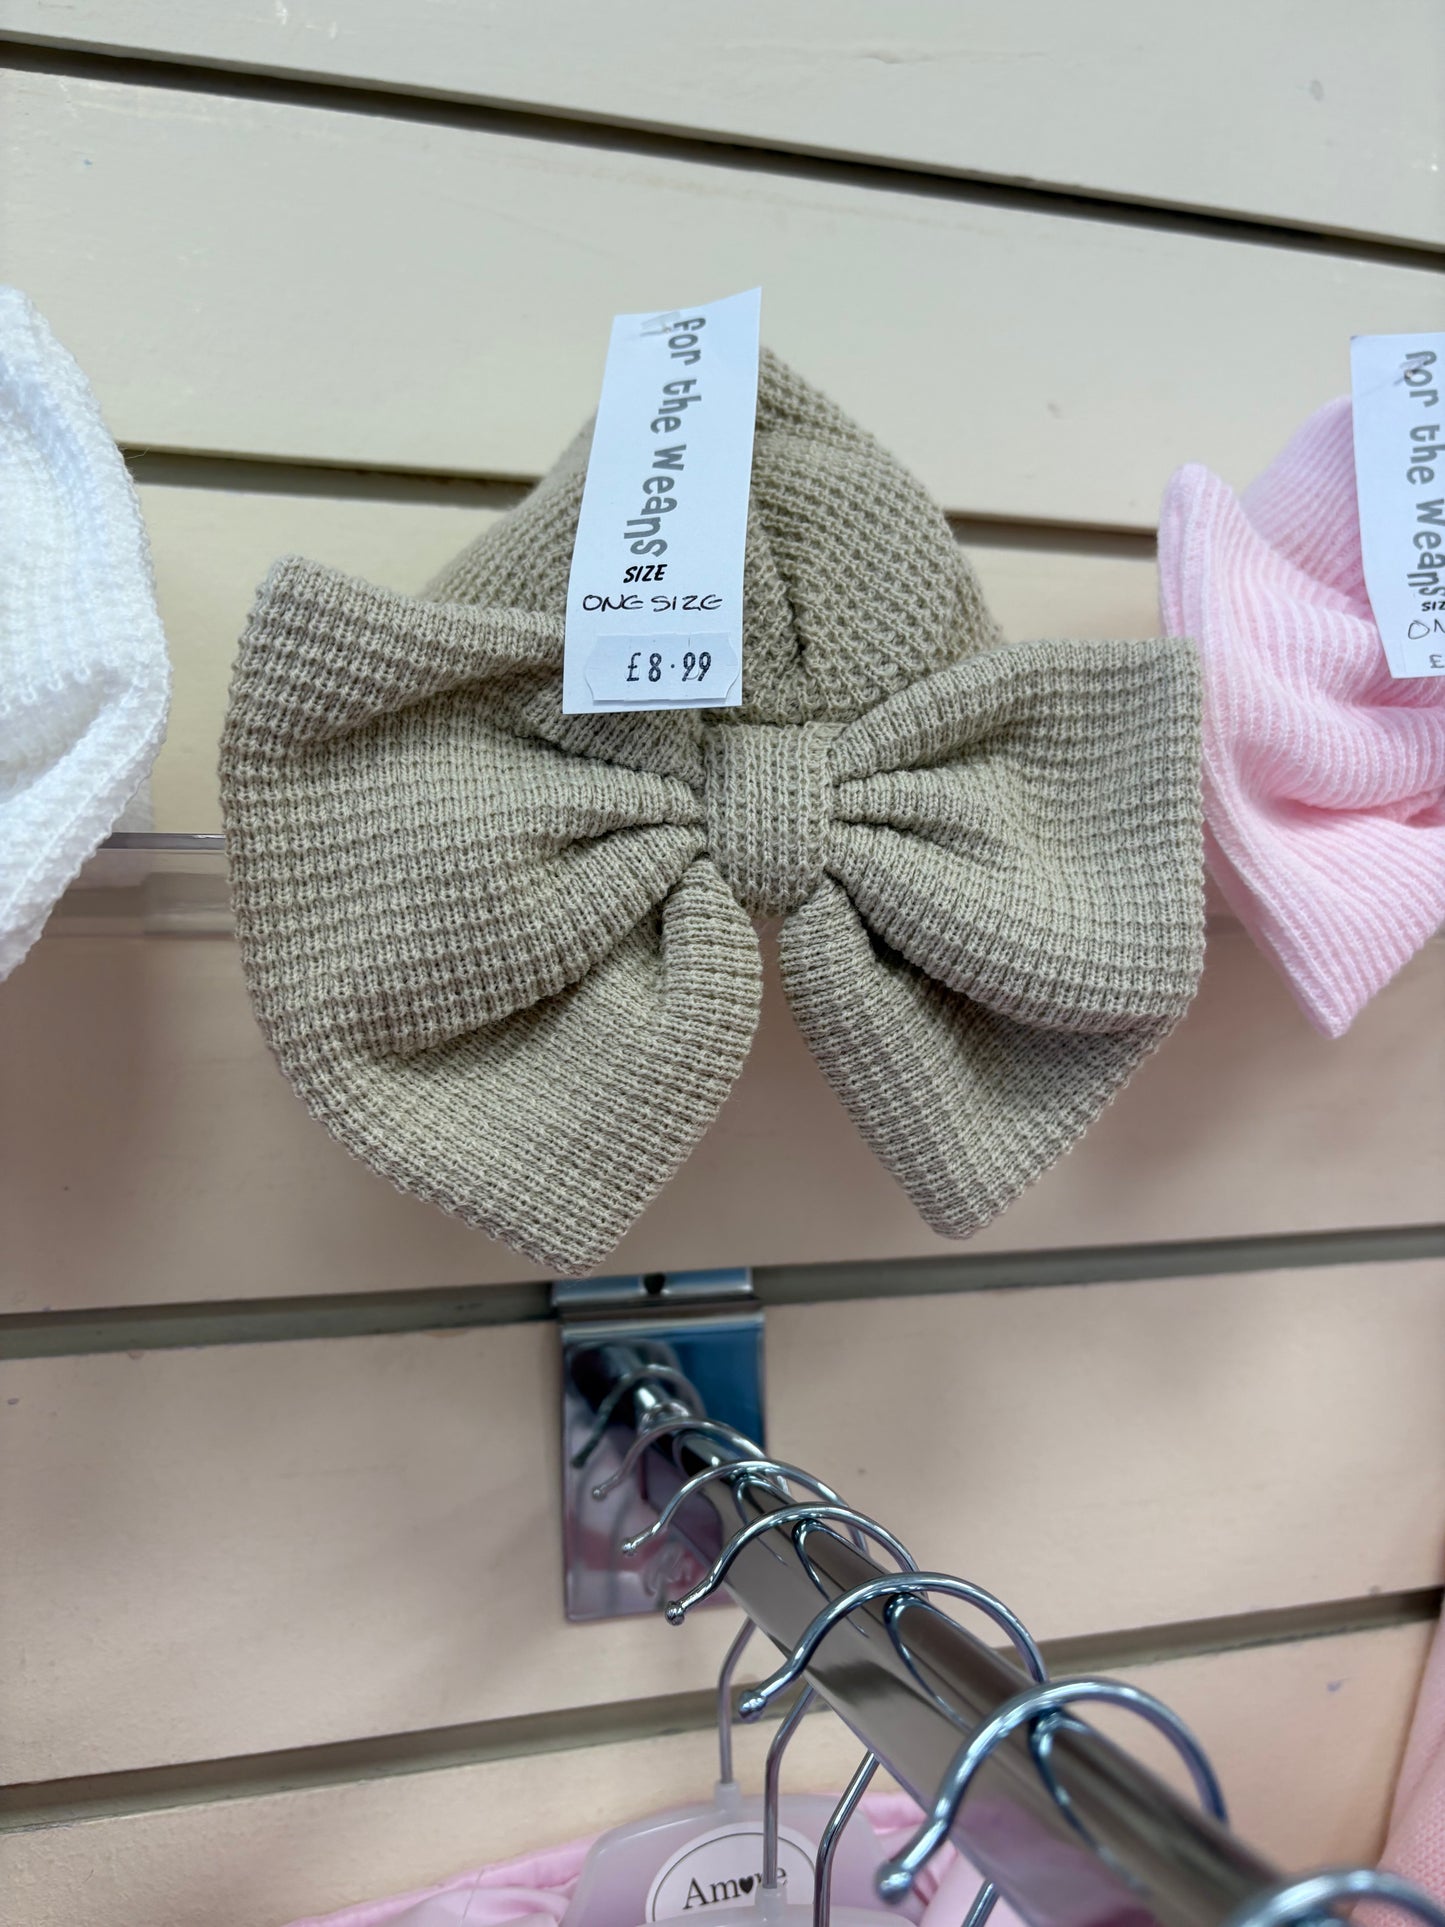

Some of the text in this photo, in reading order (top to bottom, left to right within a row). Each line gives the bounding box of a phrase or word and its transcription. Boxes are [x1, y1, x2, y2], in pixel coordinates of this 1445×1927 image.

[623, 317, 706, 557] for the weans
[1406, 424, 1445, 485] the
[623, 563, 668, 583] SIZE
[582, 594, 723, 613] ONE SIZE
[1421, 601, 1445, 612] SIZ
[1407, 618, 1445, 640] ON
[626, 651, 712, 682] £8.99
